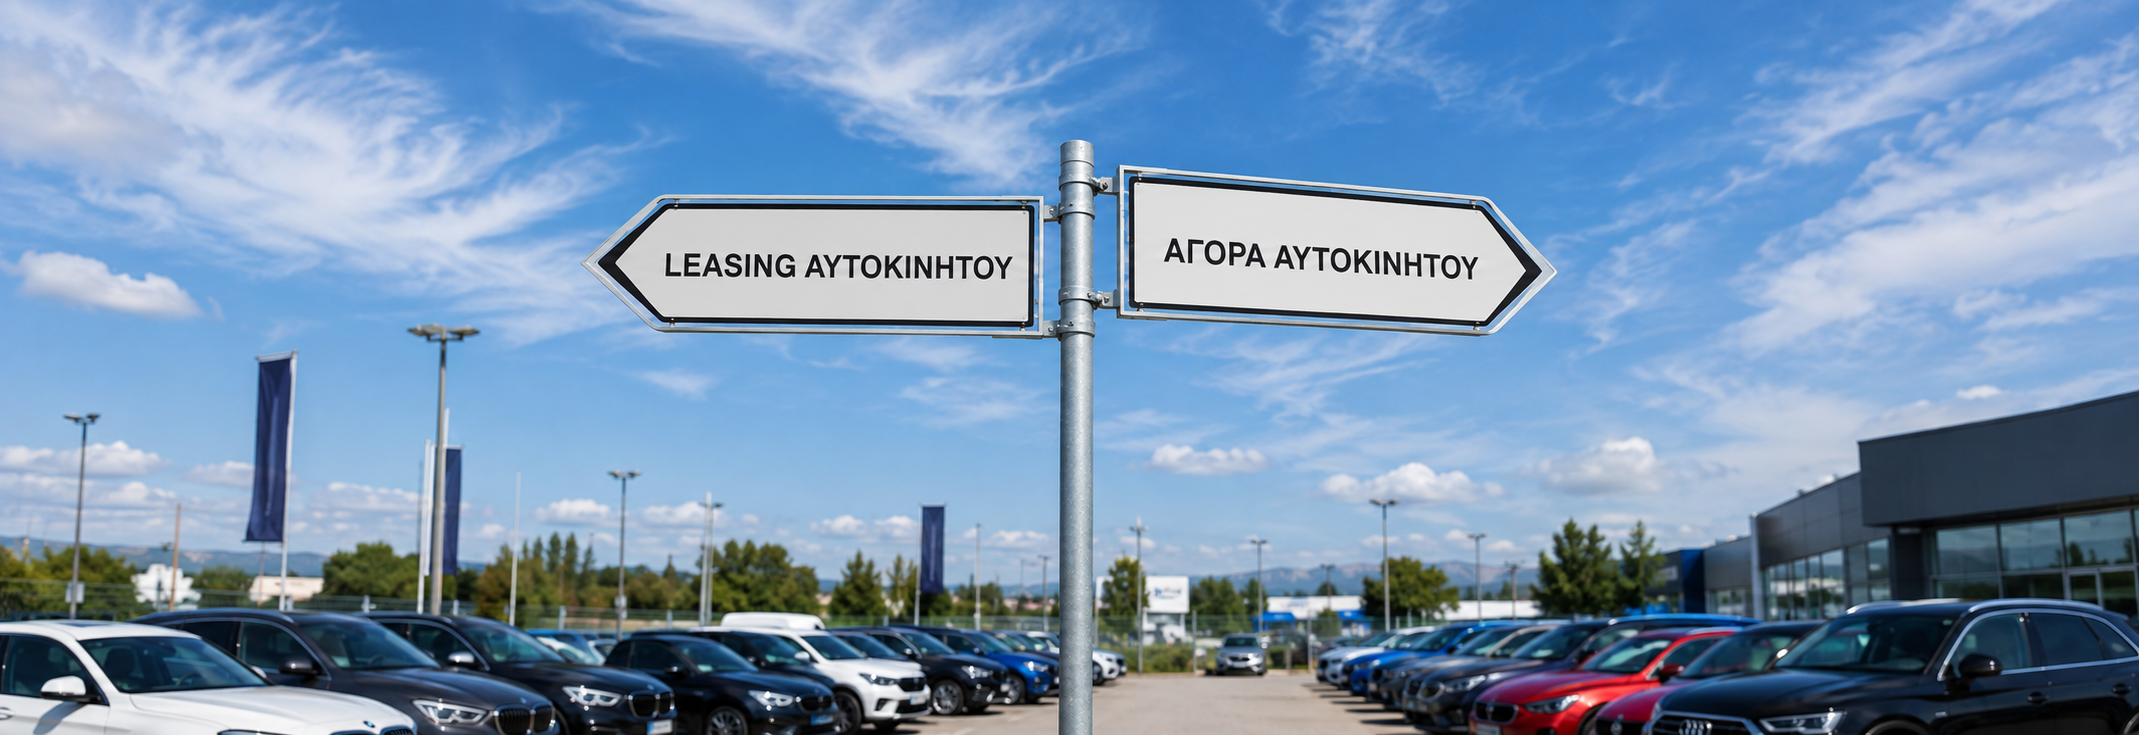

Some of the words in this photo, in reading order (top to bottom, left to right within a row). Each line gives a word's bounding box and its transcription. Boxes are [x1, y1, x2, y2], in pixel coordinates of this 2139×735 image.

[665, 252, 796, 278] LEASING
[804, 253, 1013, 280] ΑΥΤΟΚΙΝΗΤΟΥ
[1163, 238, 1267, 268] ΑΓΟΡΑ
[1273, 244, 1479, 280] ΑΥΤΟΚΙΝΗΤΟΥ
